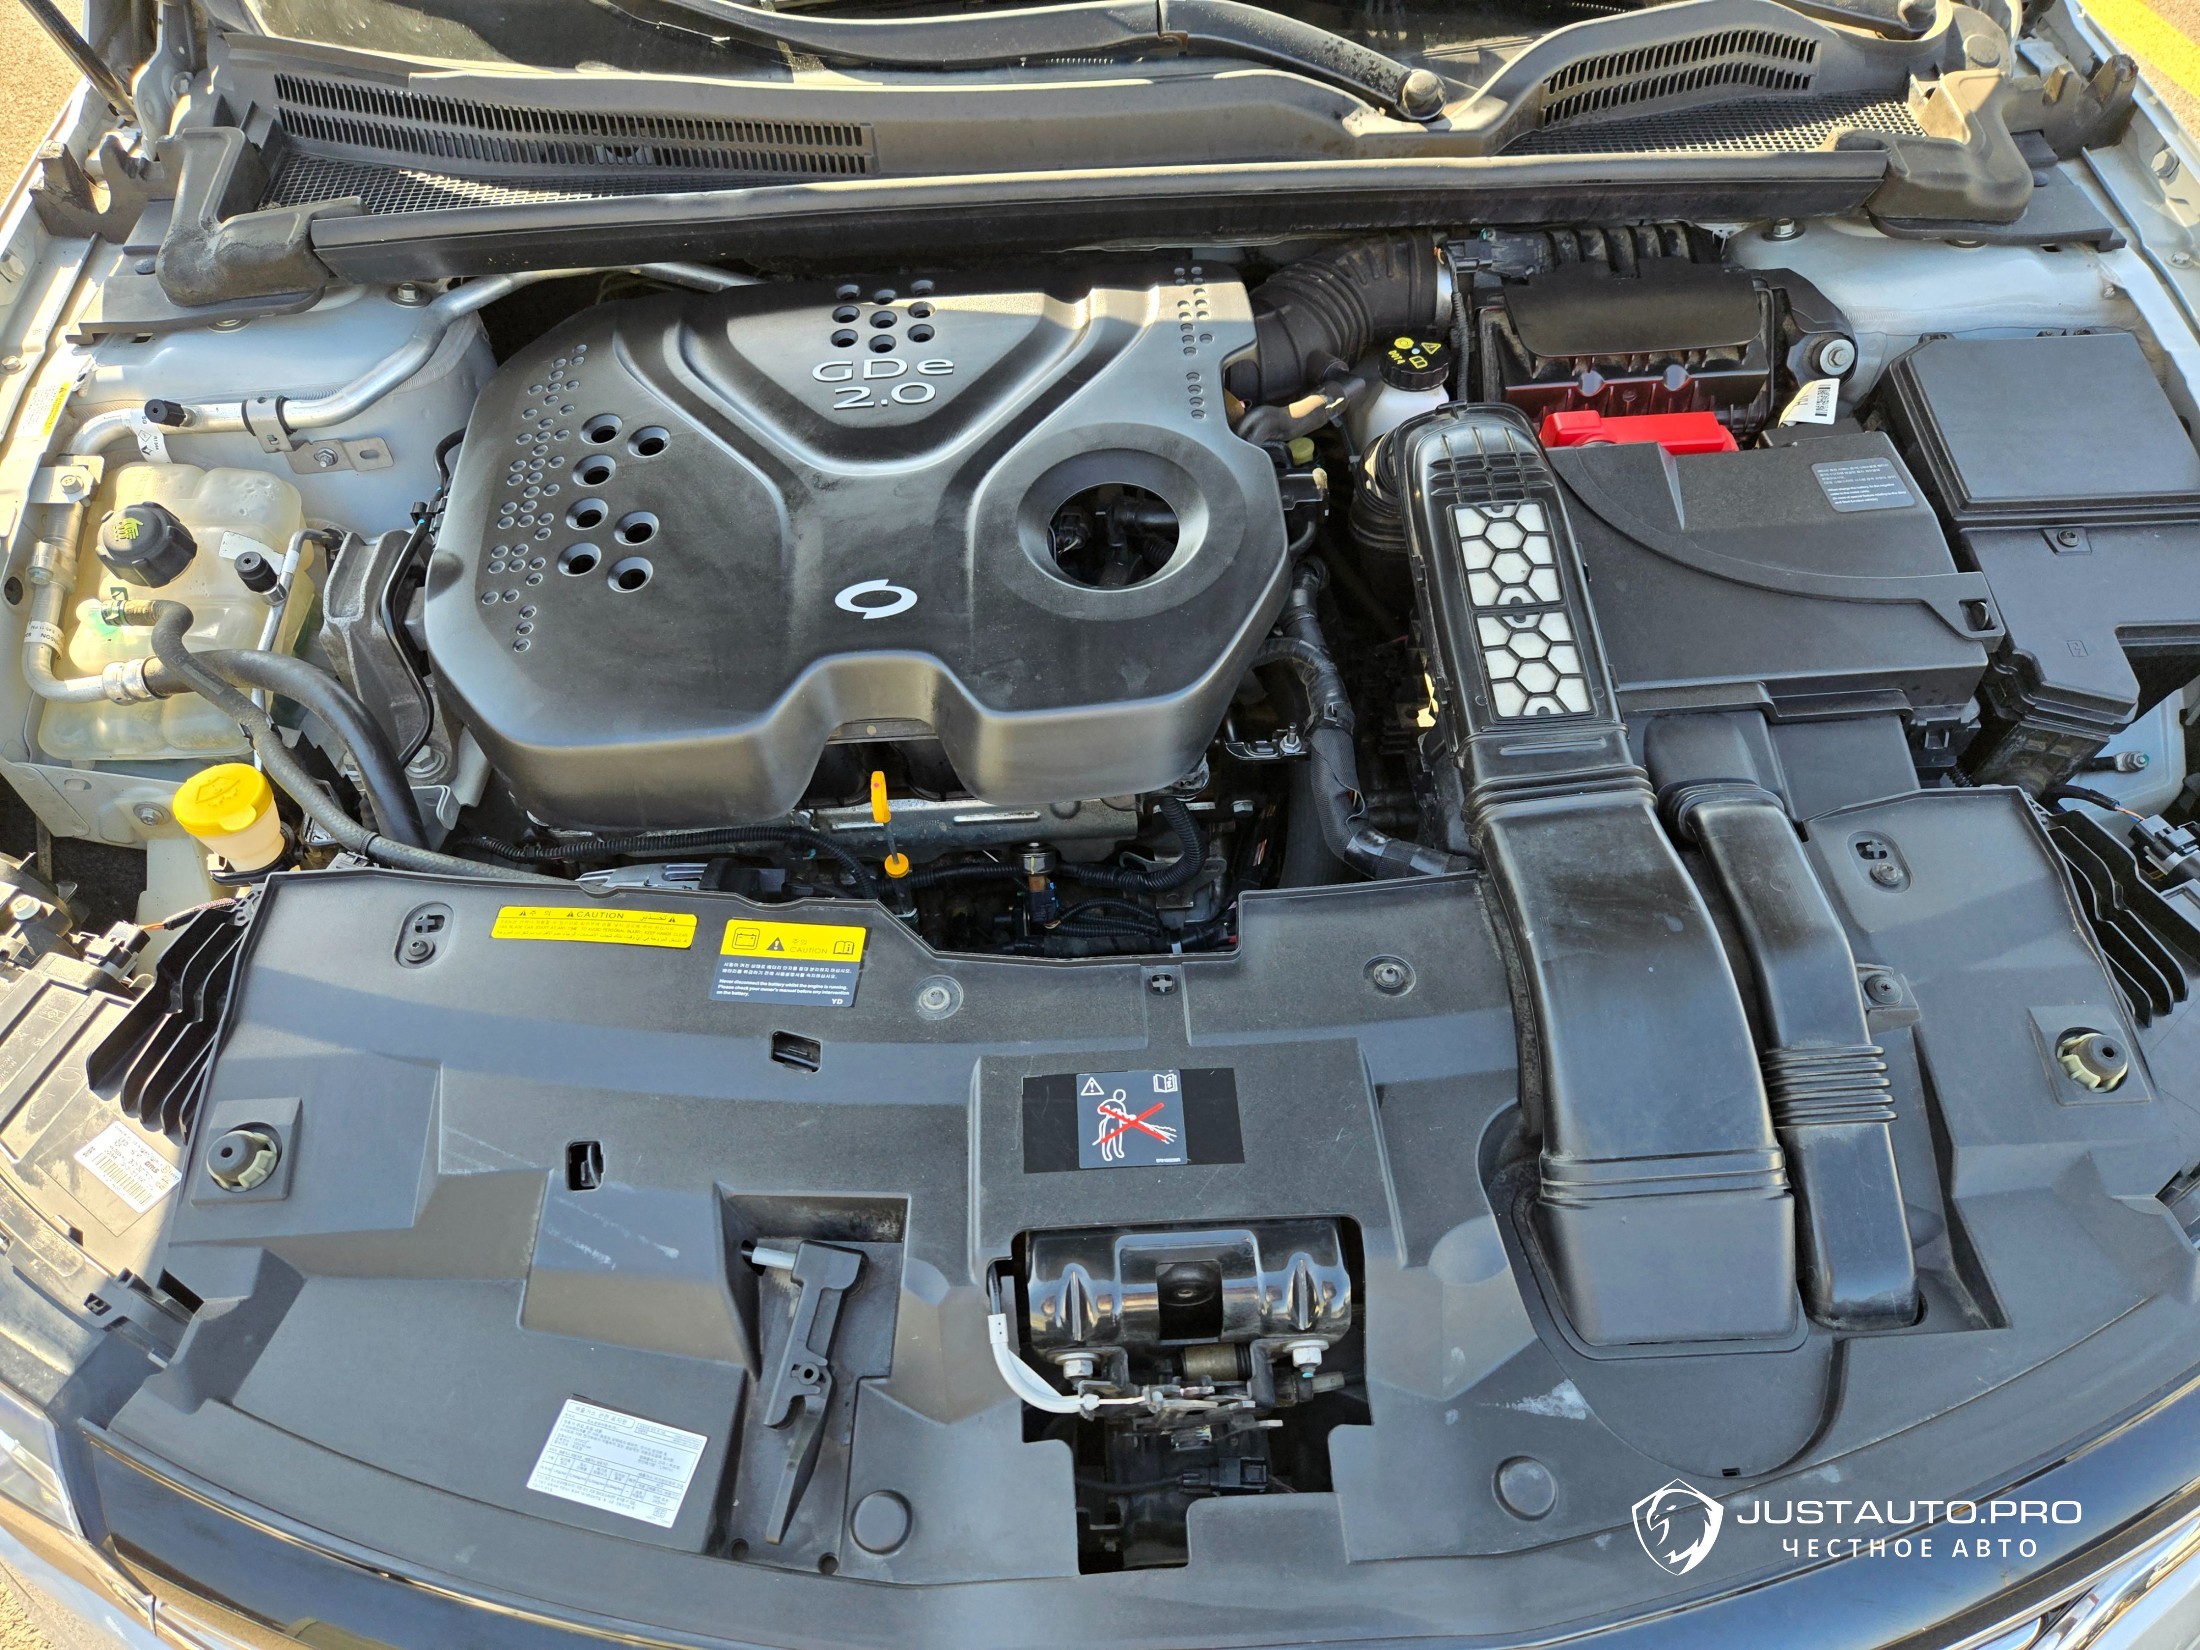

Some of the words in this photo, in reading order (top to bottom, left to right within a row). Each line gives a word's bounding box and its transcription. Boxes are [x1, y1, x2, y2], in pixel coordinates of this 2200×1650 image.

[812, 358, 954, 382] GDe
[833, 382, 936, 410] 2.0
[576, 911, 624, 919] CAUTION
